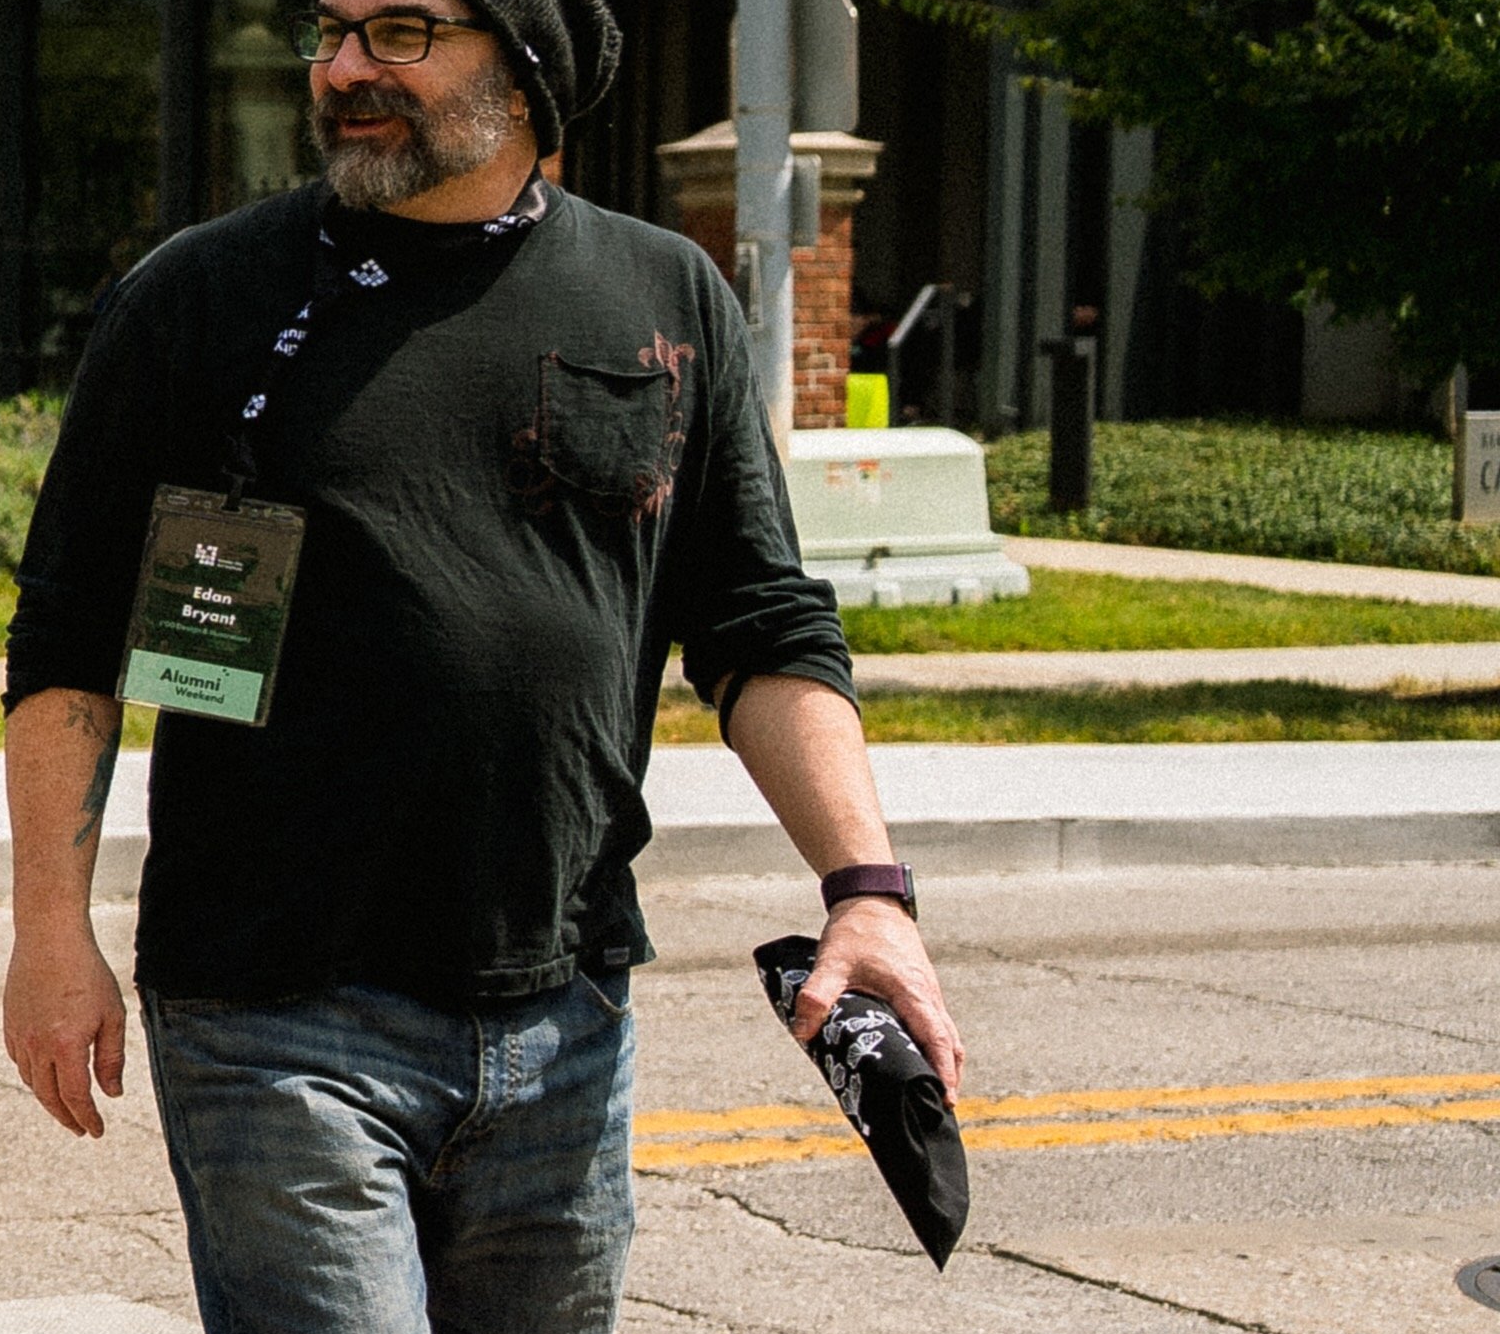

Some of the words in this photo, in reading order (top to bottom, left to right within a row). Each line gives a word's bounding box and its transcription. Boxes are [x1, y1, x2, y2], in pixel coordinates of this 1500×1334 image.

[192, 586, 232, 605] Edan
[182, 604, 237, 626] Bryant
[160, 668, 222, 692] Alumni
[175, 685, 225, 705] Weekend
